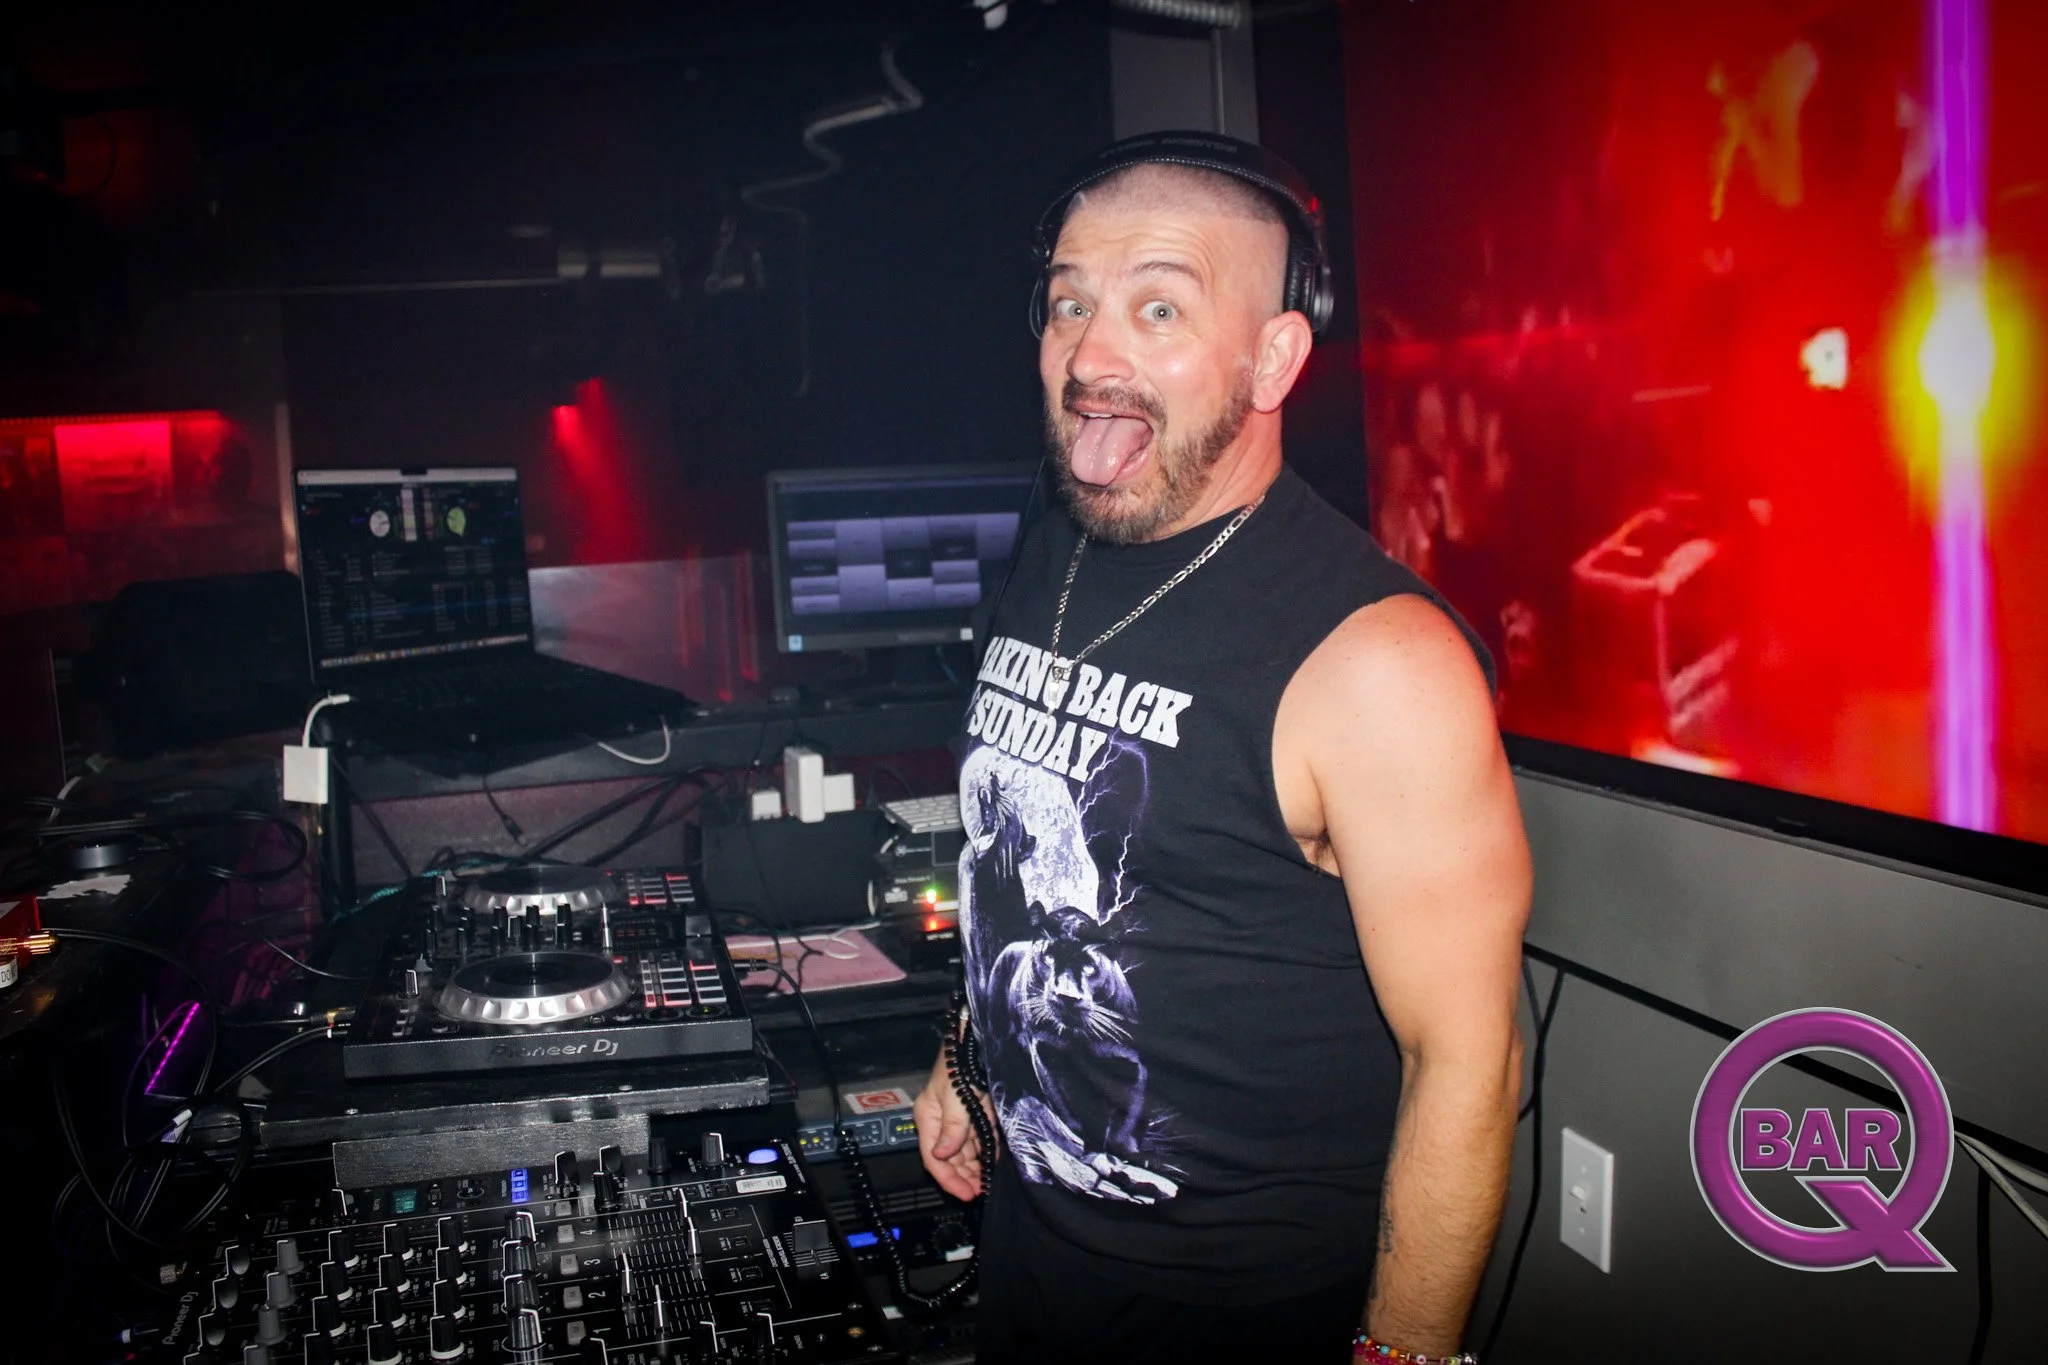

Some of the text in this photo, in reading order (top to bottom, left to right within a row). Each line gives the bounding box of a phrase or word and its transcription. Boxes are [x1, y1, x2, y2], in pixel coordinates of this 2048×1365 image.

[1066, 663, 1194, 748] BACK
[967, 688, 1108, 783] SUNDAY
[489, 1042, 588, 1060] Pioneer
[584, 1258, 601, 1267] 3
[588, 1290, 606, 1299] 2
[161, 1304, 191, 1345] Pioneer
